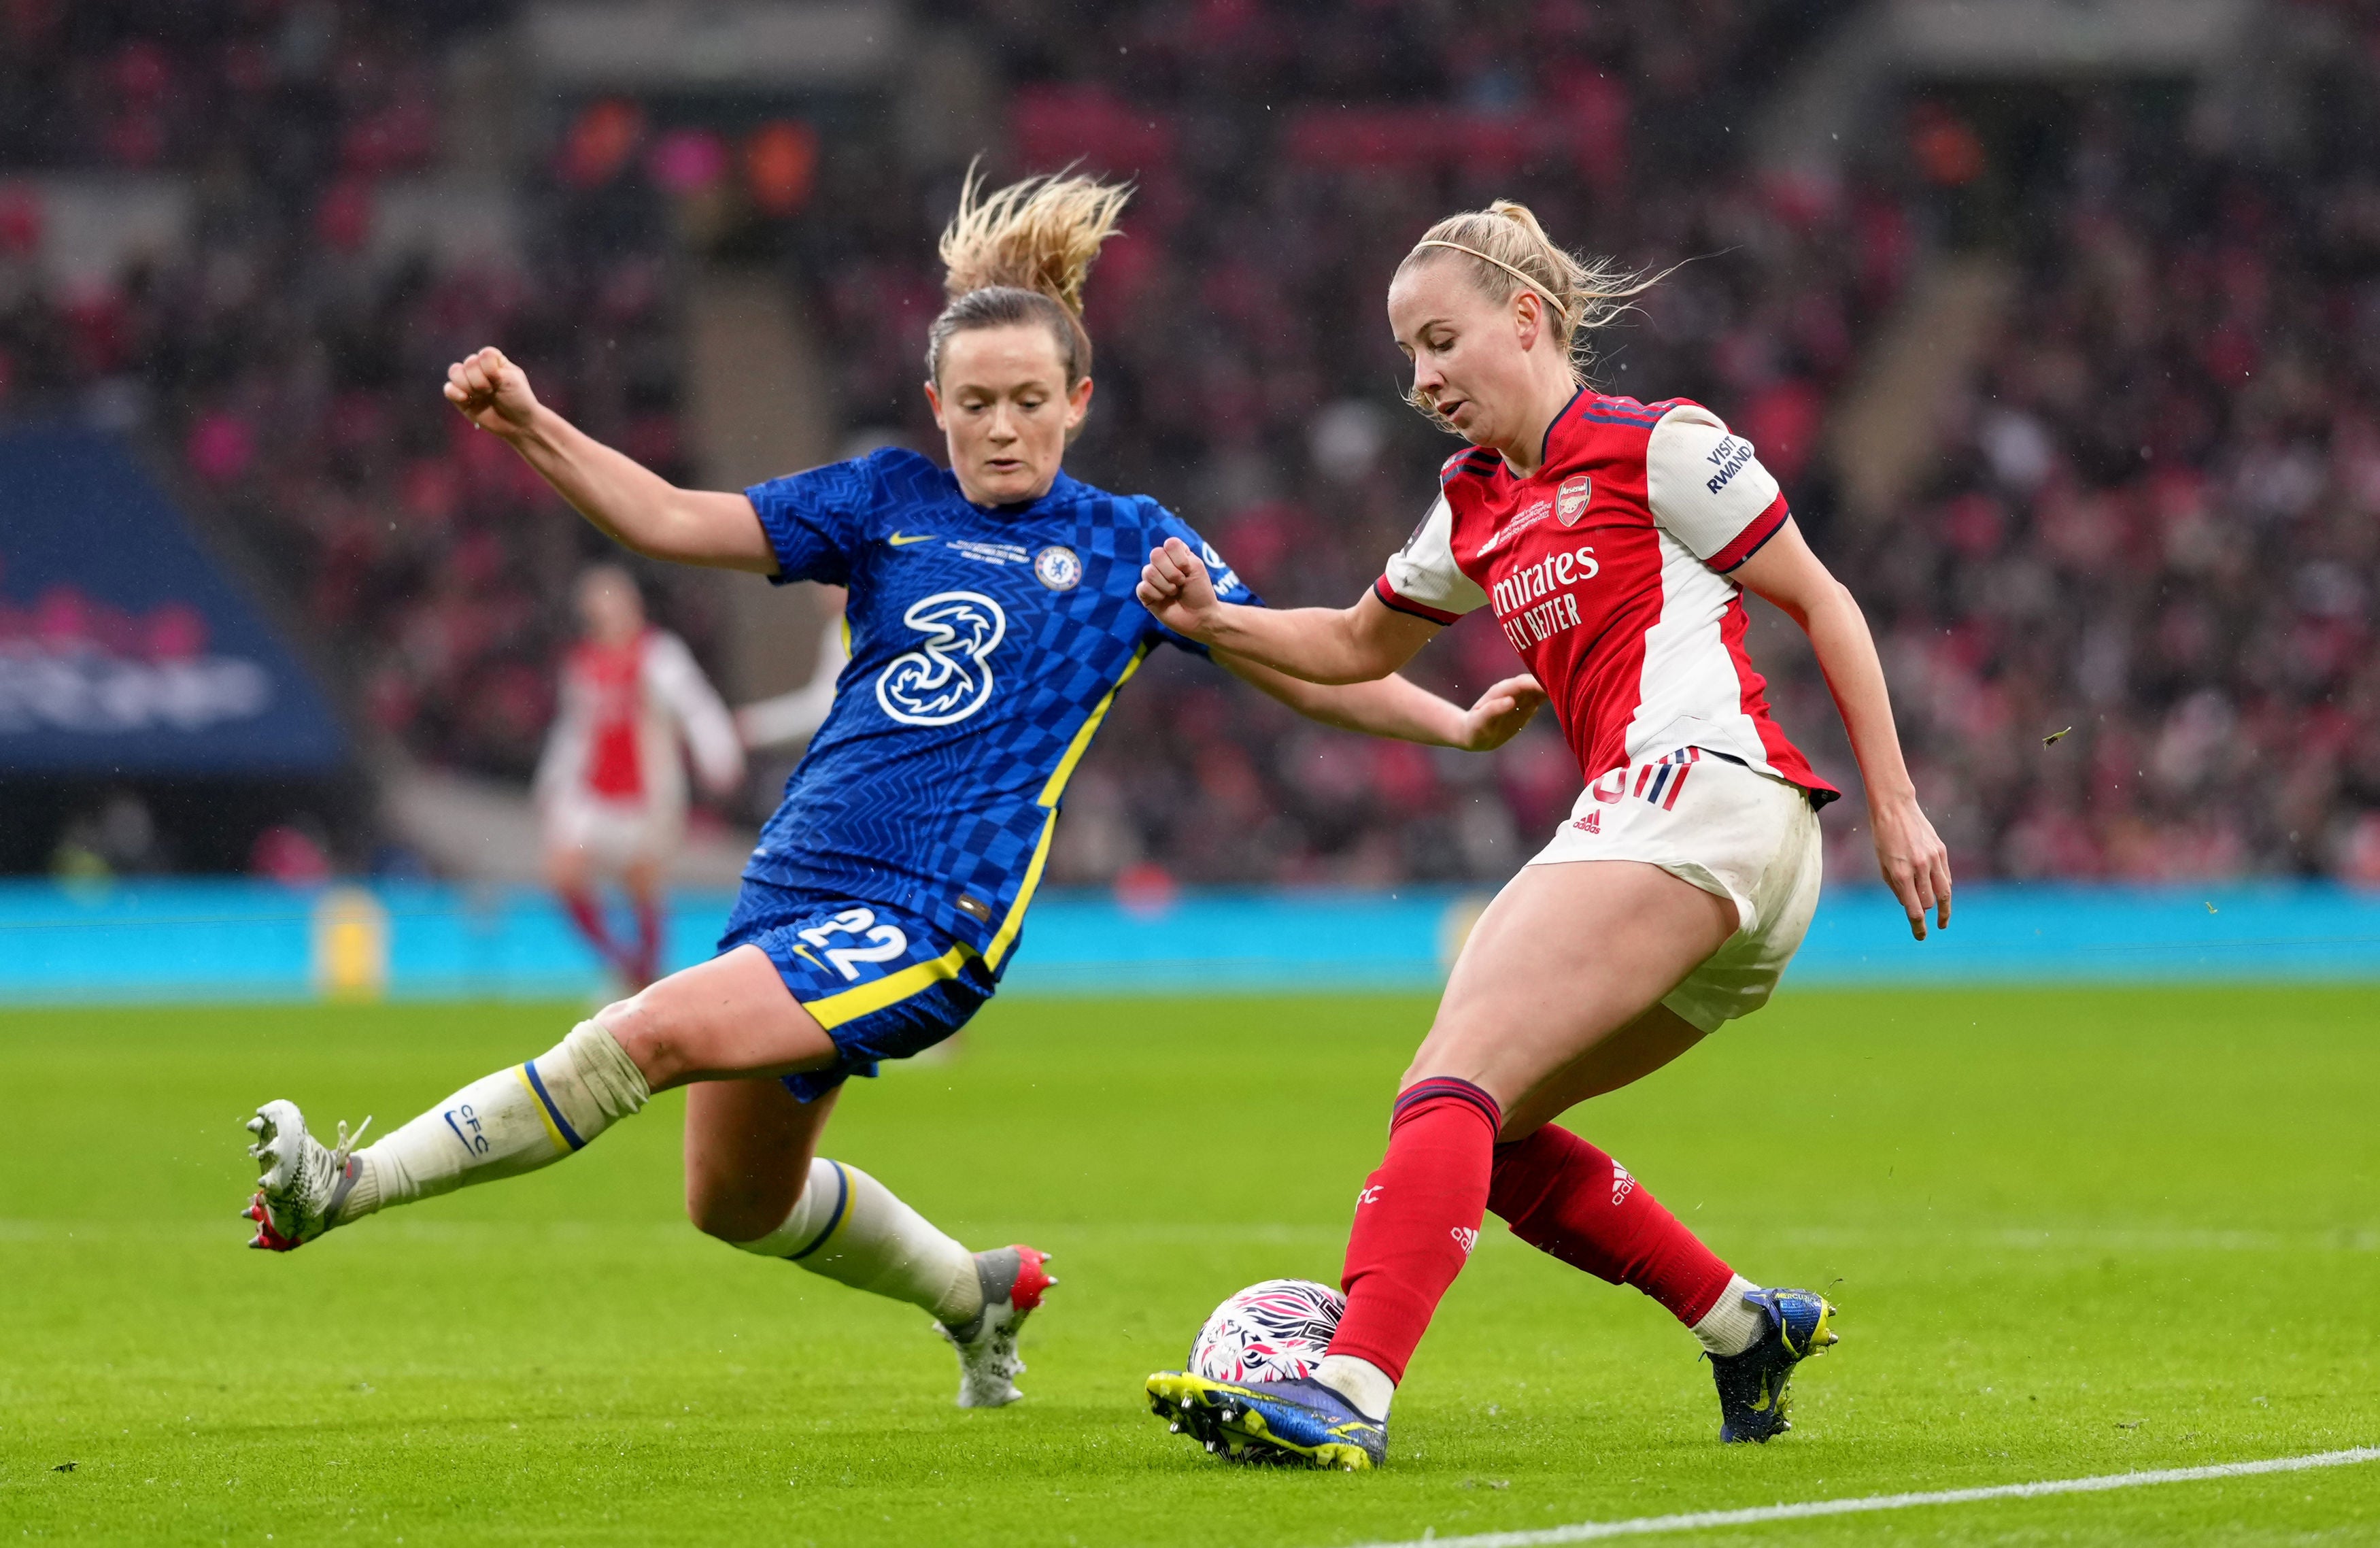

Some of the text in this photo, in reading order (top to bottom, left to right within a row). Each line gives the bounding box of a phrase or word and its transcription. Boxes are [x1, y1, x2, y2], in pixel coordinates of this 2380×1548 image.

[1707, 435, 1737, 466] VISIT
[1562, 482, 1586, 494] Arsenal
[1493, 546, 1599, 618] mirates
[1503, 592, 1582, 653] FLY BETTER
[876, 590, 1006, 726] 3
[1573, 821, 1601, 835] adidas
[798, 907, 908, 981] 22
[461, 1105, 489, 1154] CFC
